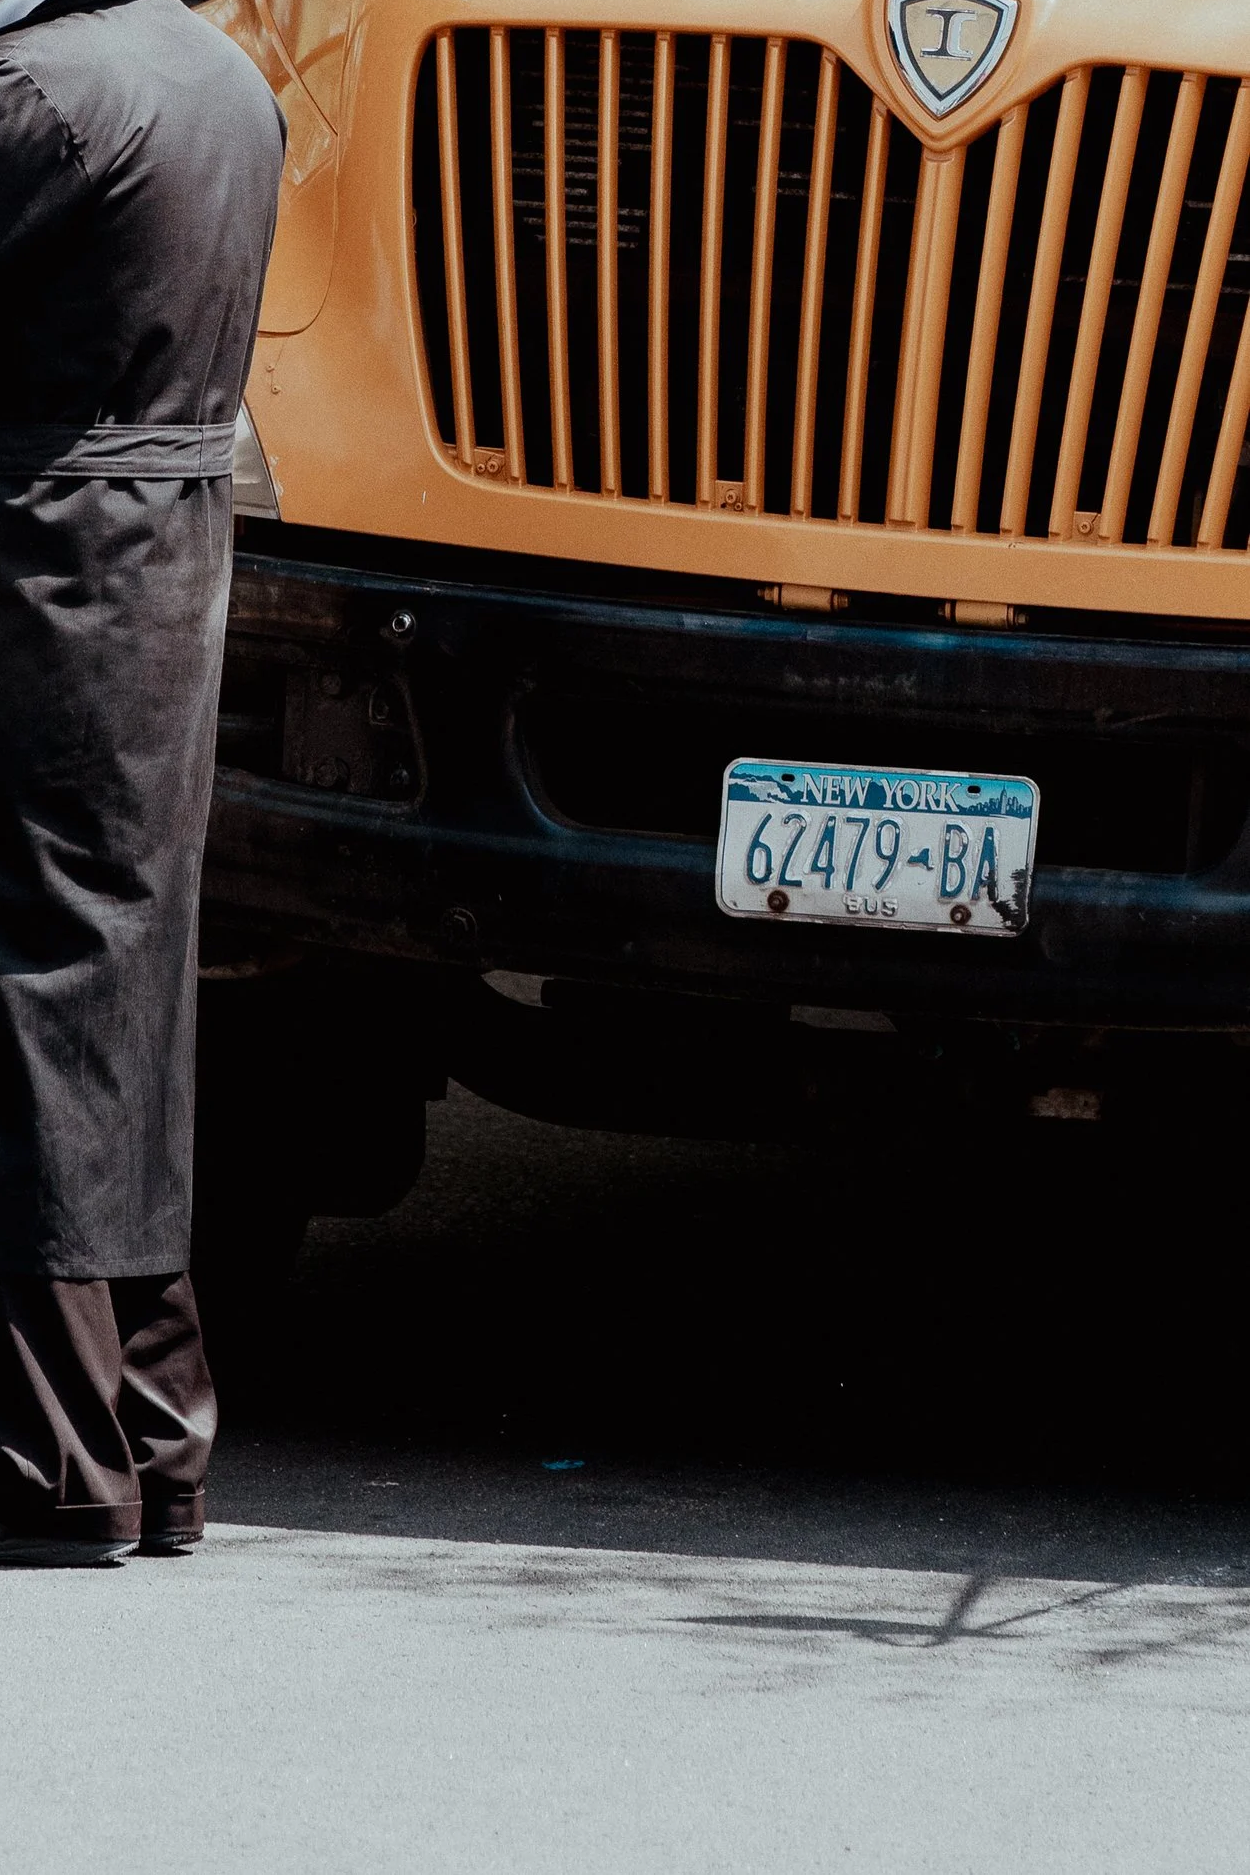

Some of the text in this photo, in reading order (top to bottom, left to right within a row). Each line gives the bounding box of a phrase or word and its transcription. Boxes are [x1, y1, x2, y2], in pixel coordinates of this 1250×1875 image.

[800, 773, 963, 813] NEW YORK
[843, 894, 899, 917] BUS
